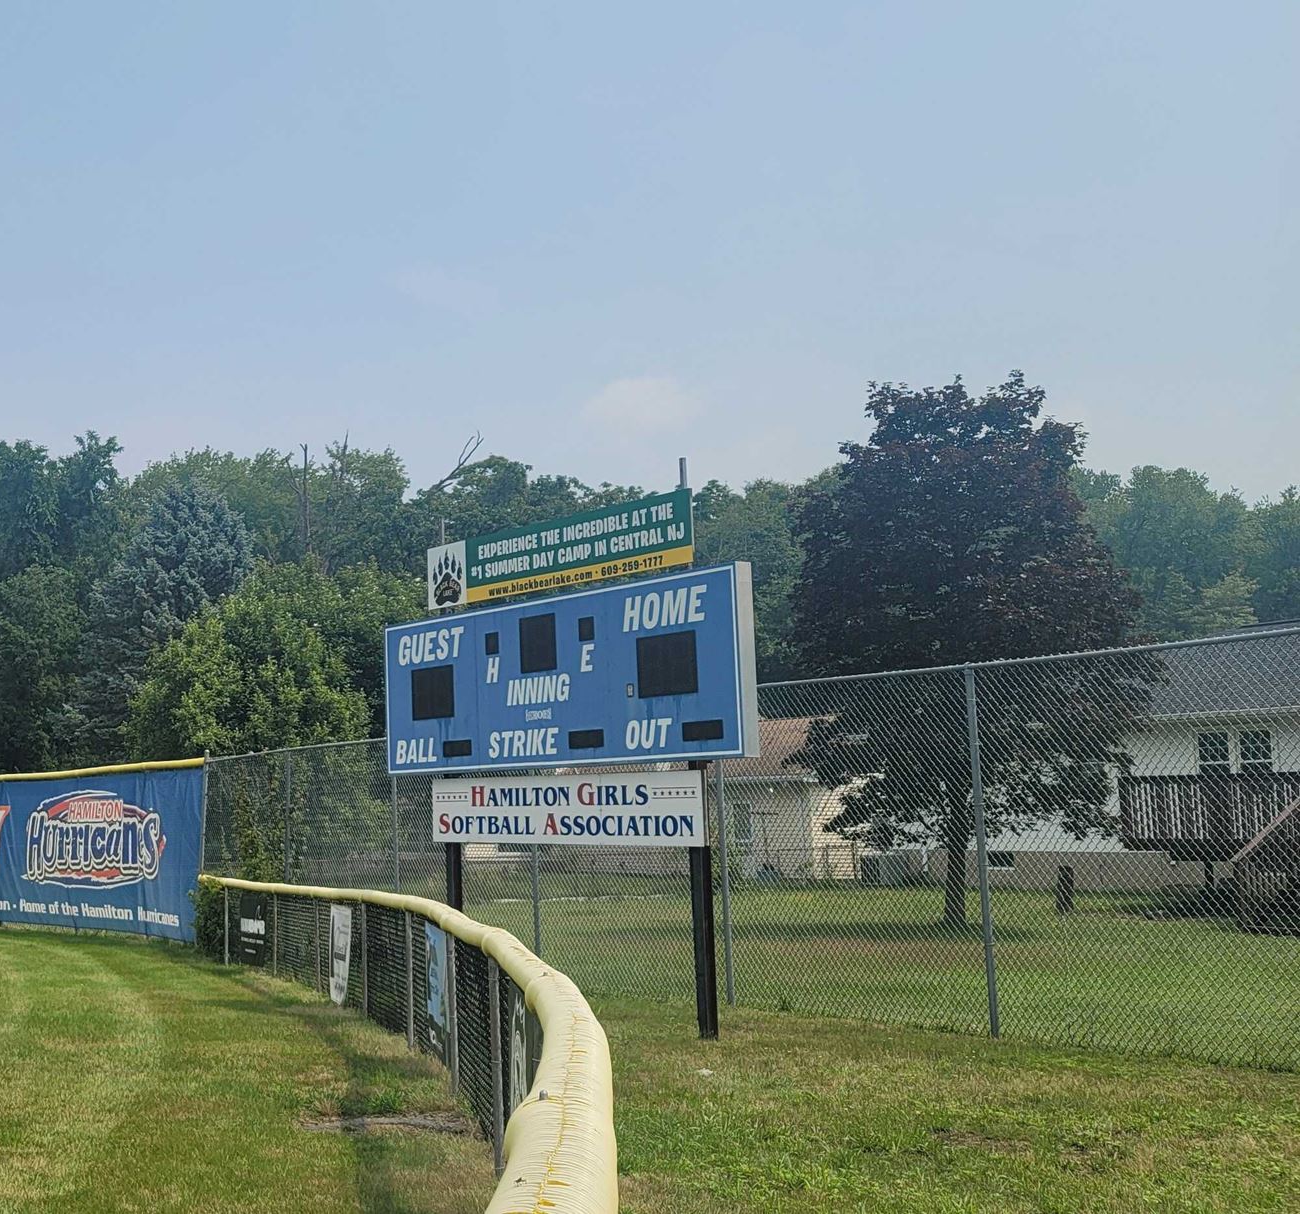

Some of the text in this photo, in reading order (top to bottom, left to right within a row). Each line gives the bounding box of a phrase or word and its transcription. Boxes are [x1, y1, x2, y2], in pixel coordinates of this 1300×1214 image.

[478, 502, 673, 560] EXPERIENCE THE INCREDIBLE AT THE
[471, 522, 685, 579] #1 SUMMER DAY CAMP IN CENTRAL NJ
[488, 555, 663, 597] www.blackbearlake.com 609-259-1777
[622, 584, 708, 633] HOME
[398, 626, 465, 666] GUEST
[580, 643, 595, 672] E
[486, 656, 500, 684] H
[506, 673, 570, 706] INNING
[488, 727, 559, 759] STRIKE
[625, 717, 673, 750] OUT
[395, 737, 438, 765] BALL
[68, 799, 124, 822] HAMILTON
[471, 783, 649, 807] HAMILTON GIRLS
[439, 813, 694, 837] SOFTBALL ASSOCIATION
[19, 898, 47, 914] Home
[48, 900, 59, 914] of
[61, 901, 79, 916] the
[80, 903, 134, 921] Hamilton
[137, 906, 180, 927] Hurricanes
